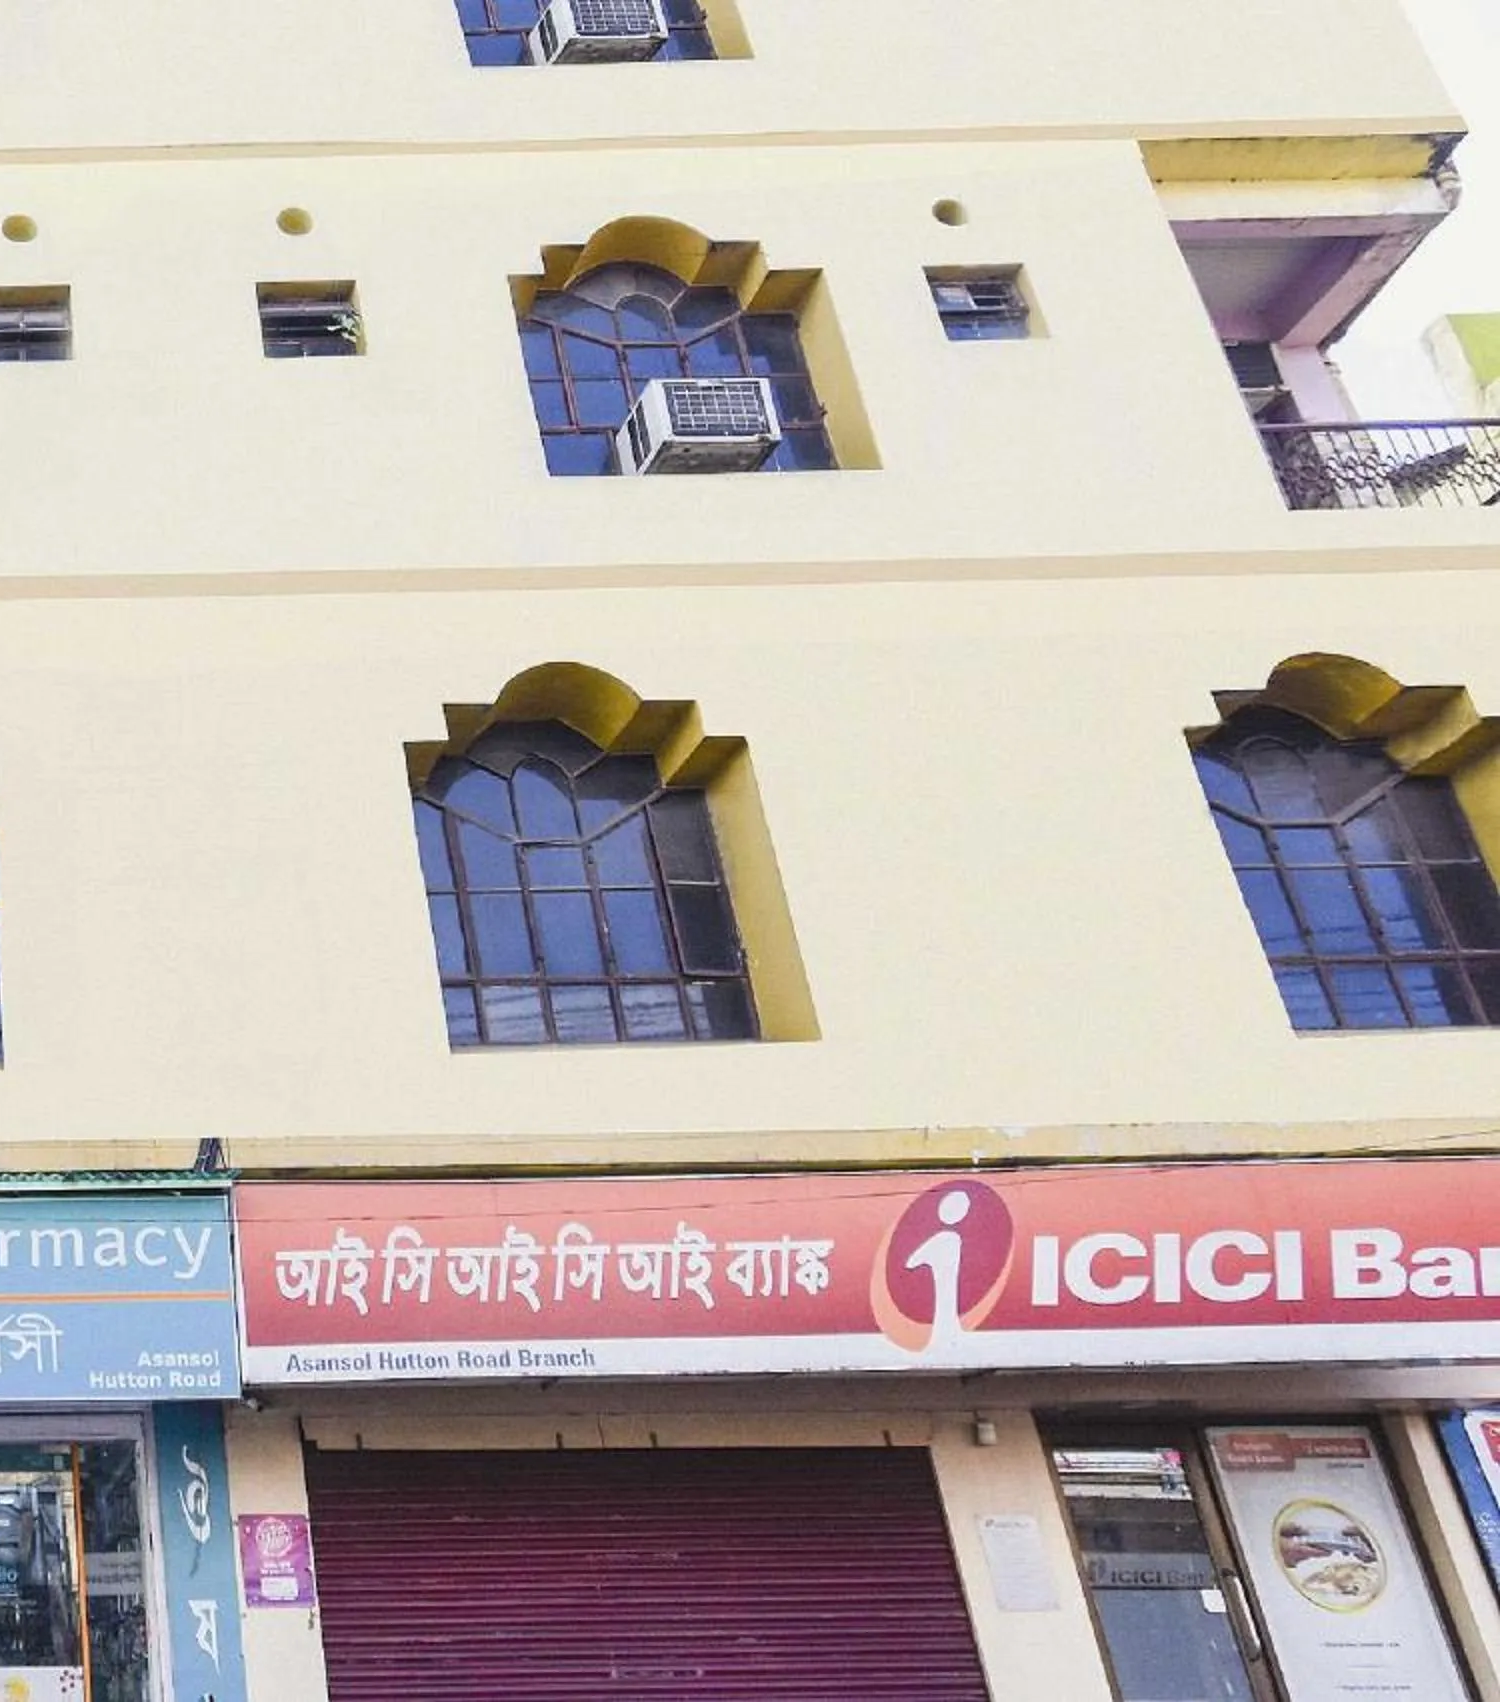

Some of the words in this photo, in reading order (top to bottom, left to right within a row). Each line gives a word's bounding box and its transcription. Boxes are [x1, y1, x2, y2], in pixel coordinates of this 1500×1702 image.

[1031, 1230, 1304, 1307] ICICI
[138, 1350, 220, 1369] Asansol
[286, 1351, 372, 1373] Asansol
[378, 1351, 450, 1371] Hutton
[456, 1350, 511, 1370] Road
[517, 1348, 596, 1369] Branch
[89, 1371, 162, 1389] Hutton
[170, 1371, 221, 1388] Road
[1111, 1569, 1162, 1585] ICICI
